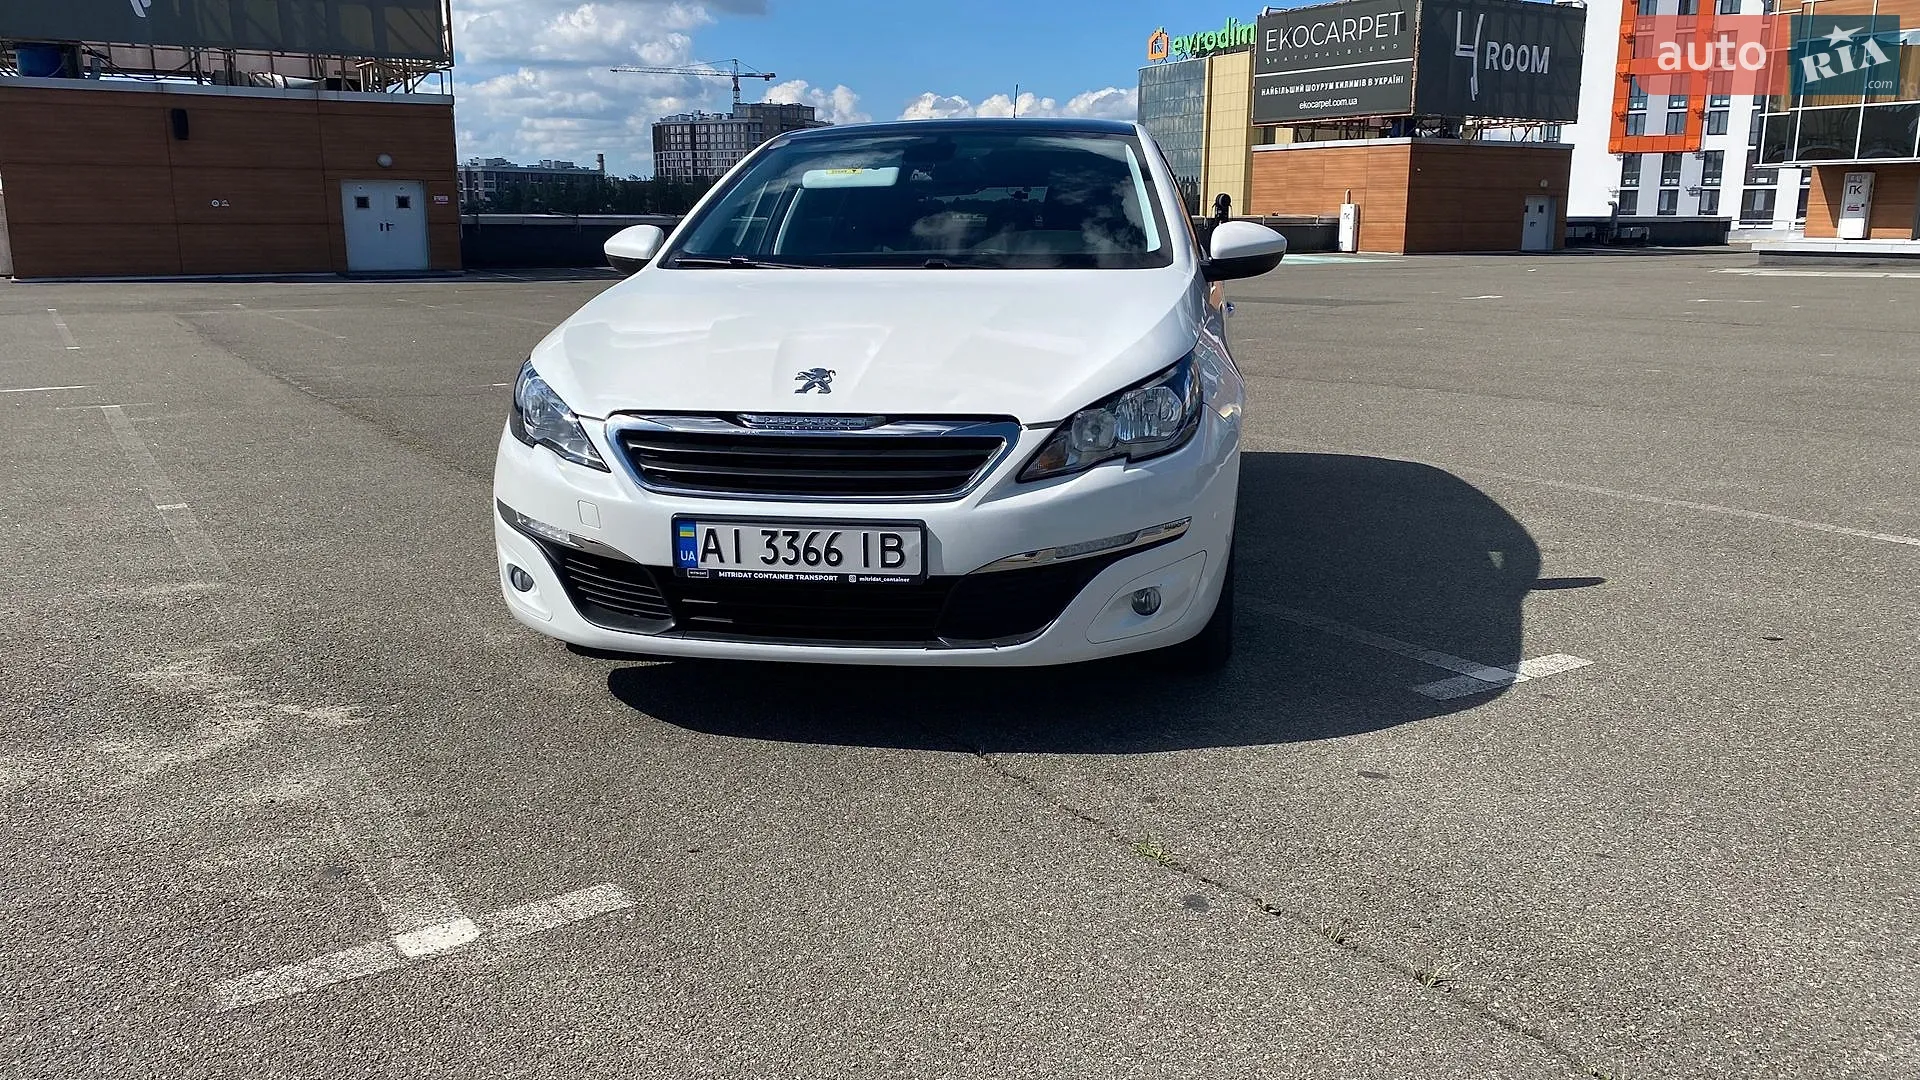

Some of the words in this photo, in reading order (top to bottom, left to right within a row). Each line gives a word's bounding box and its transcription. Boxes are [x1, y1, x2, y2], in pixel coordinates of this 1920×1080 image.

[1172, 17, 1256, 56] evrodim
[1266, 11, 1404, 51] EKOCARPET
[1485, 41, 1550, 74] ROOM
[1261, 83, 1304, 96] НАЙБІЛЬШИЙ
[1305, 81, 1334, 92] ШОУРУМ
[1335, 79, 1367, 90] КИЛИМІВ
[1368, 78, 1373, 86] В
[1374, 74, 1404, 86] УКРАЇНІ
[1299, 97, 1358, 110] ekocarpet.com.ua
[1849, 185, 1863, 194] ПК
[680, 550, 696, 561] UA
[700, 527, 741, 564] AI
[760, 529, 844, 567] 3366
[862, 532, 906, 568] IB
[719, 571, 752, 579] MITRIDAT
[753, 572, 794, 580] CONTAINER
